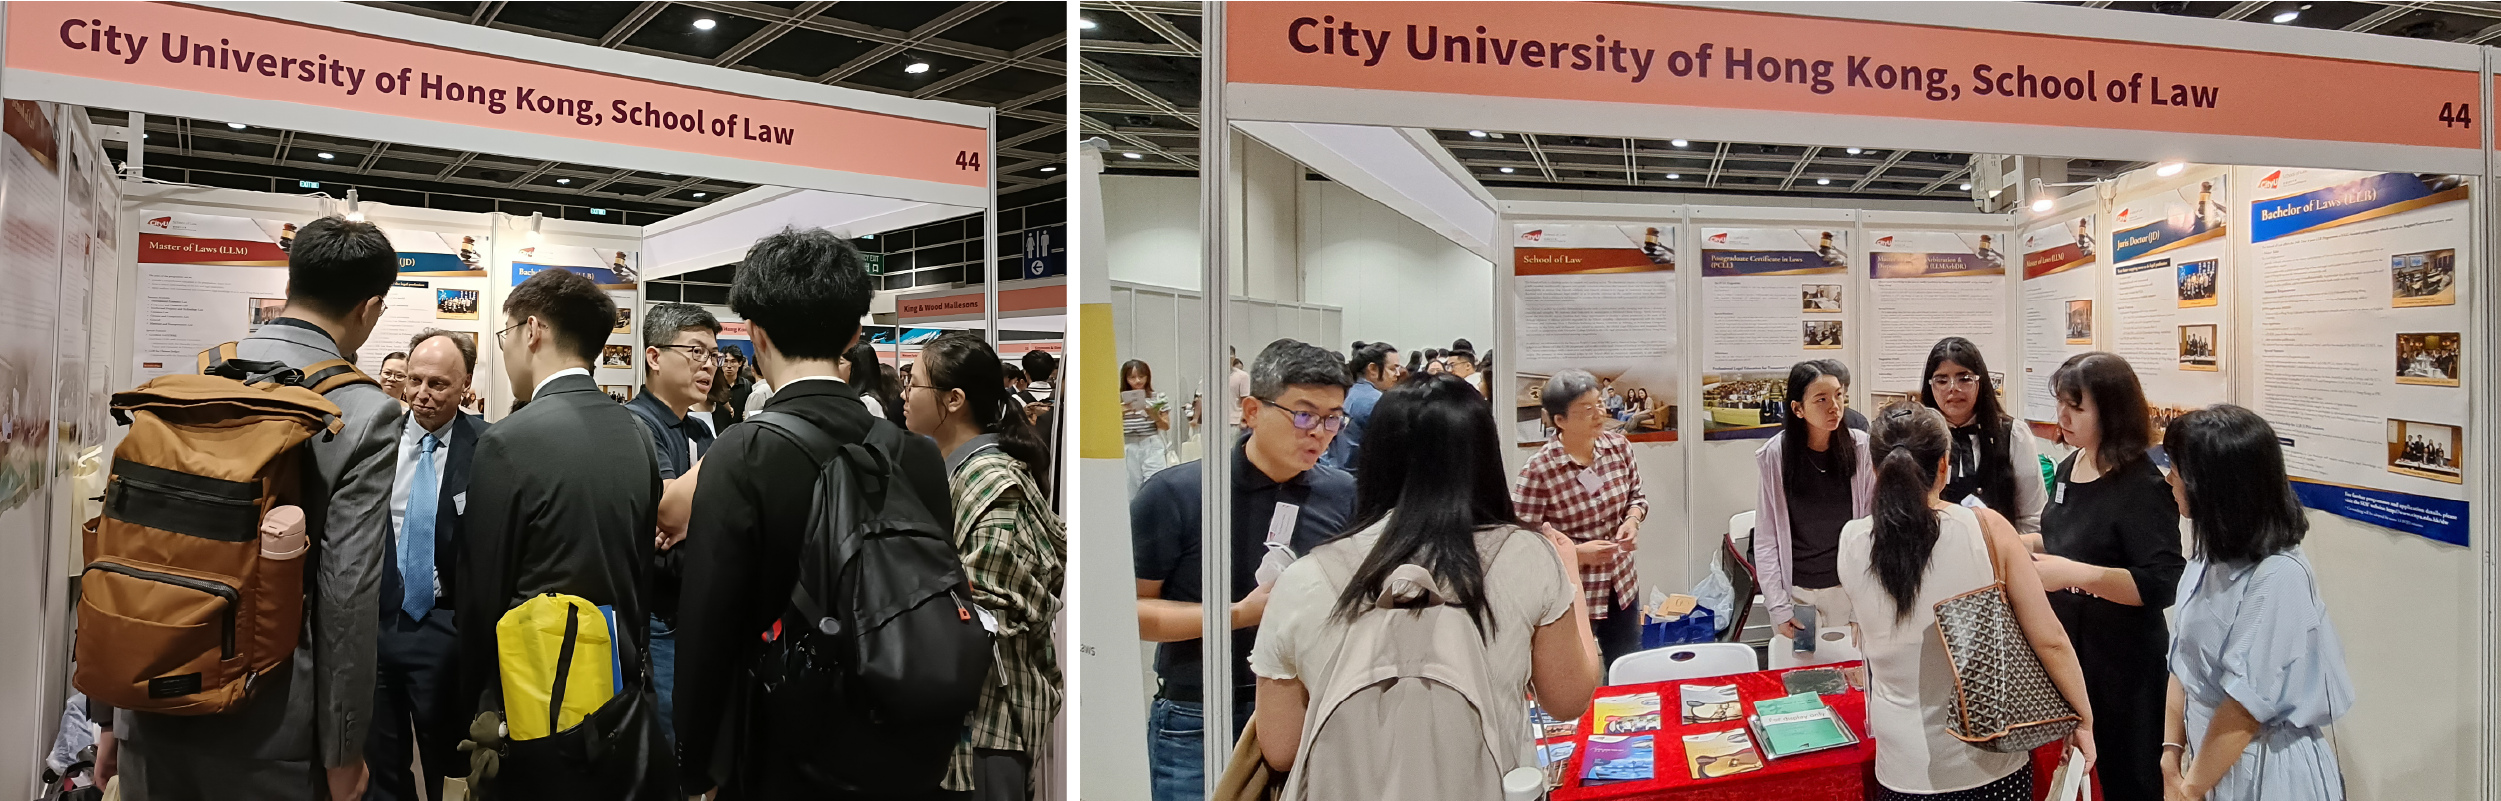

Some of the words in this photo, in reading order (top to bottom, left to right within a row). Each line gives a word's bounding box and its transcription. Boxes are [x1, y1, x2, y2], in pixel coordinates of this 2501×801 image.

[1288, 15, 1391, 67] City
[1406, 24, 1655, 83] University
[1667, 42, 1714, 78] of
[1725, 46, 1835, 95] Hong
[1847, 55, 1961, 102] Kong,
[1972, 63, 2098, 102] School
[2106, 72, 2144, 104] of
[2151, 76, 2219, 109] Law
[59, 18, 149, 65] City
[161, 32, 366, 96] University
[375, 67, 412, 97] of
[420, 72, 507, 115] Hong
[516, 86, 603, 127] Kong,
[611, 99, 705, 135] School
[711, 113, 738, 138] of
[744, 117, 795, 146] Law
[2438, 101, 2472, 129] 44
[955, 150, 981, 172] 44
[2261, 203, 2301, 221] Bachelor
[2303, 199, 2317, 213] of
[2316, 199, 2341, 210] Laws
[2344, 188, 2377, 206] (LLB)
[149, 219, 170, 228] CityU
[2116, 239, 2129, 251] Juris
[2129, 235, 2148, 246] Doctor
[2148, 230, 2160, 244] (JD)
[149, 241, 181, 251] Master
[183, 243, 195, 252] of
[195, 244, 217, 253] Laws
[219, 246, 248, 255] (LLM)
[399, 258, 416, 267] (JD)
[1523, 254, 1552, 263] School
[1554, 254, 1565, 263] of
[1565, 255, 1583, 263] Law
[1711, 254, 1749, 263] Postgraduate
[904, 305, 918, 313] King
[924, 303, 943, 311] Wood
[944, 301, 979, 309] Mallesons
[2442, 512, 2457, 520] please
